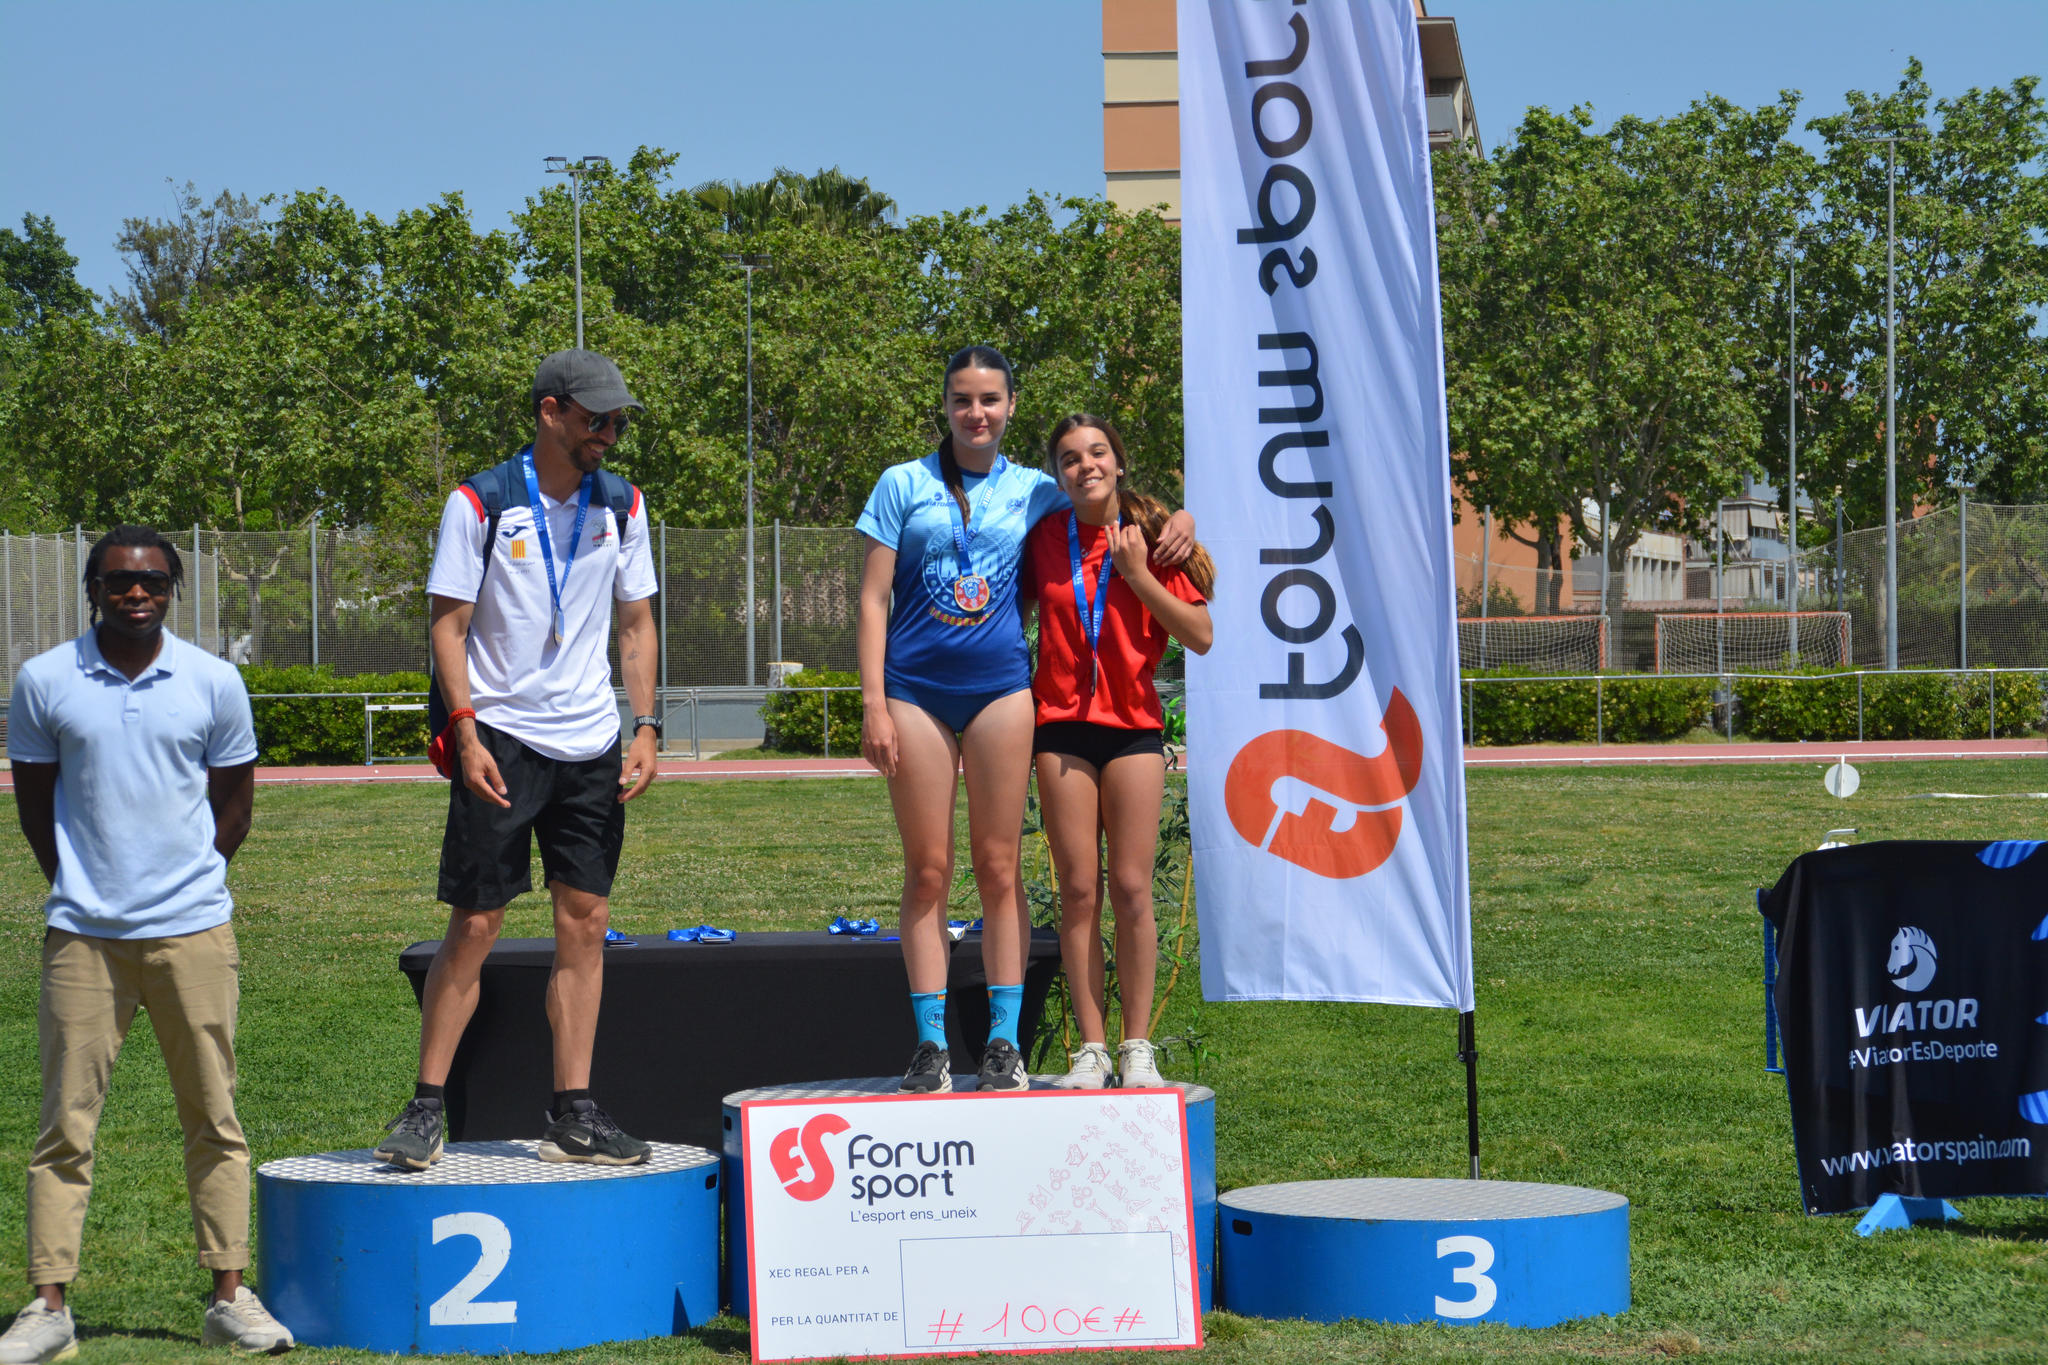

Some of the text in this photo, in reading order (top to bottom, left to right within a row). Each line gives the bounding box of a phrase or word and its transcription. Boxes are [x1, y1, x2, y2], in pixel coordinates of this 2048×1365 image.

[1854, 998, 1979, 1038] VIATOR
[850, 1169, 954, 1206] sport
[850, 1209, 906, 1224] L'esport
[429, 1212, 518, 1326] 2
[769, 1265, 870, 1279] XEC REGAL PER A
[1434, 1235, 1497, 1319] 3
[771, 1312, 899, 1326] PER LA QUANTITAT DE
